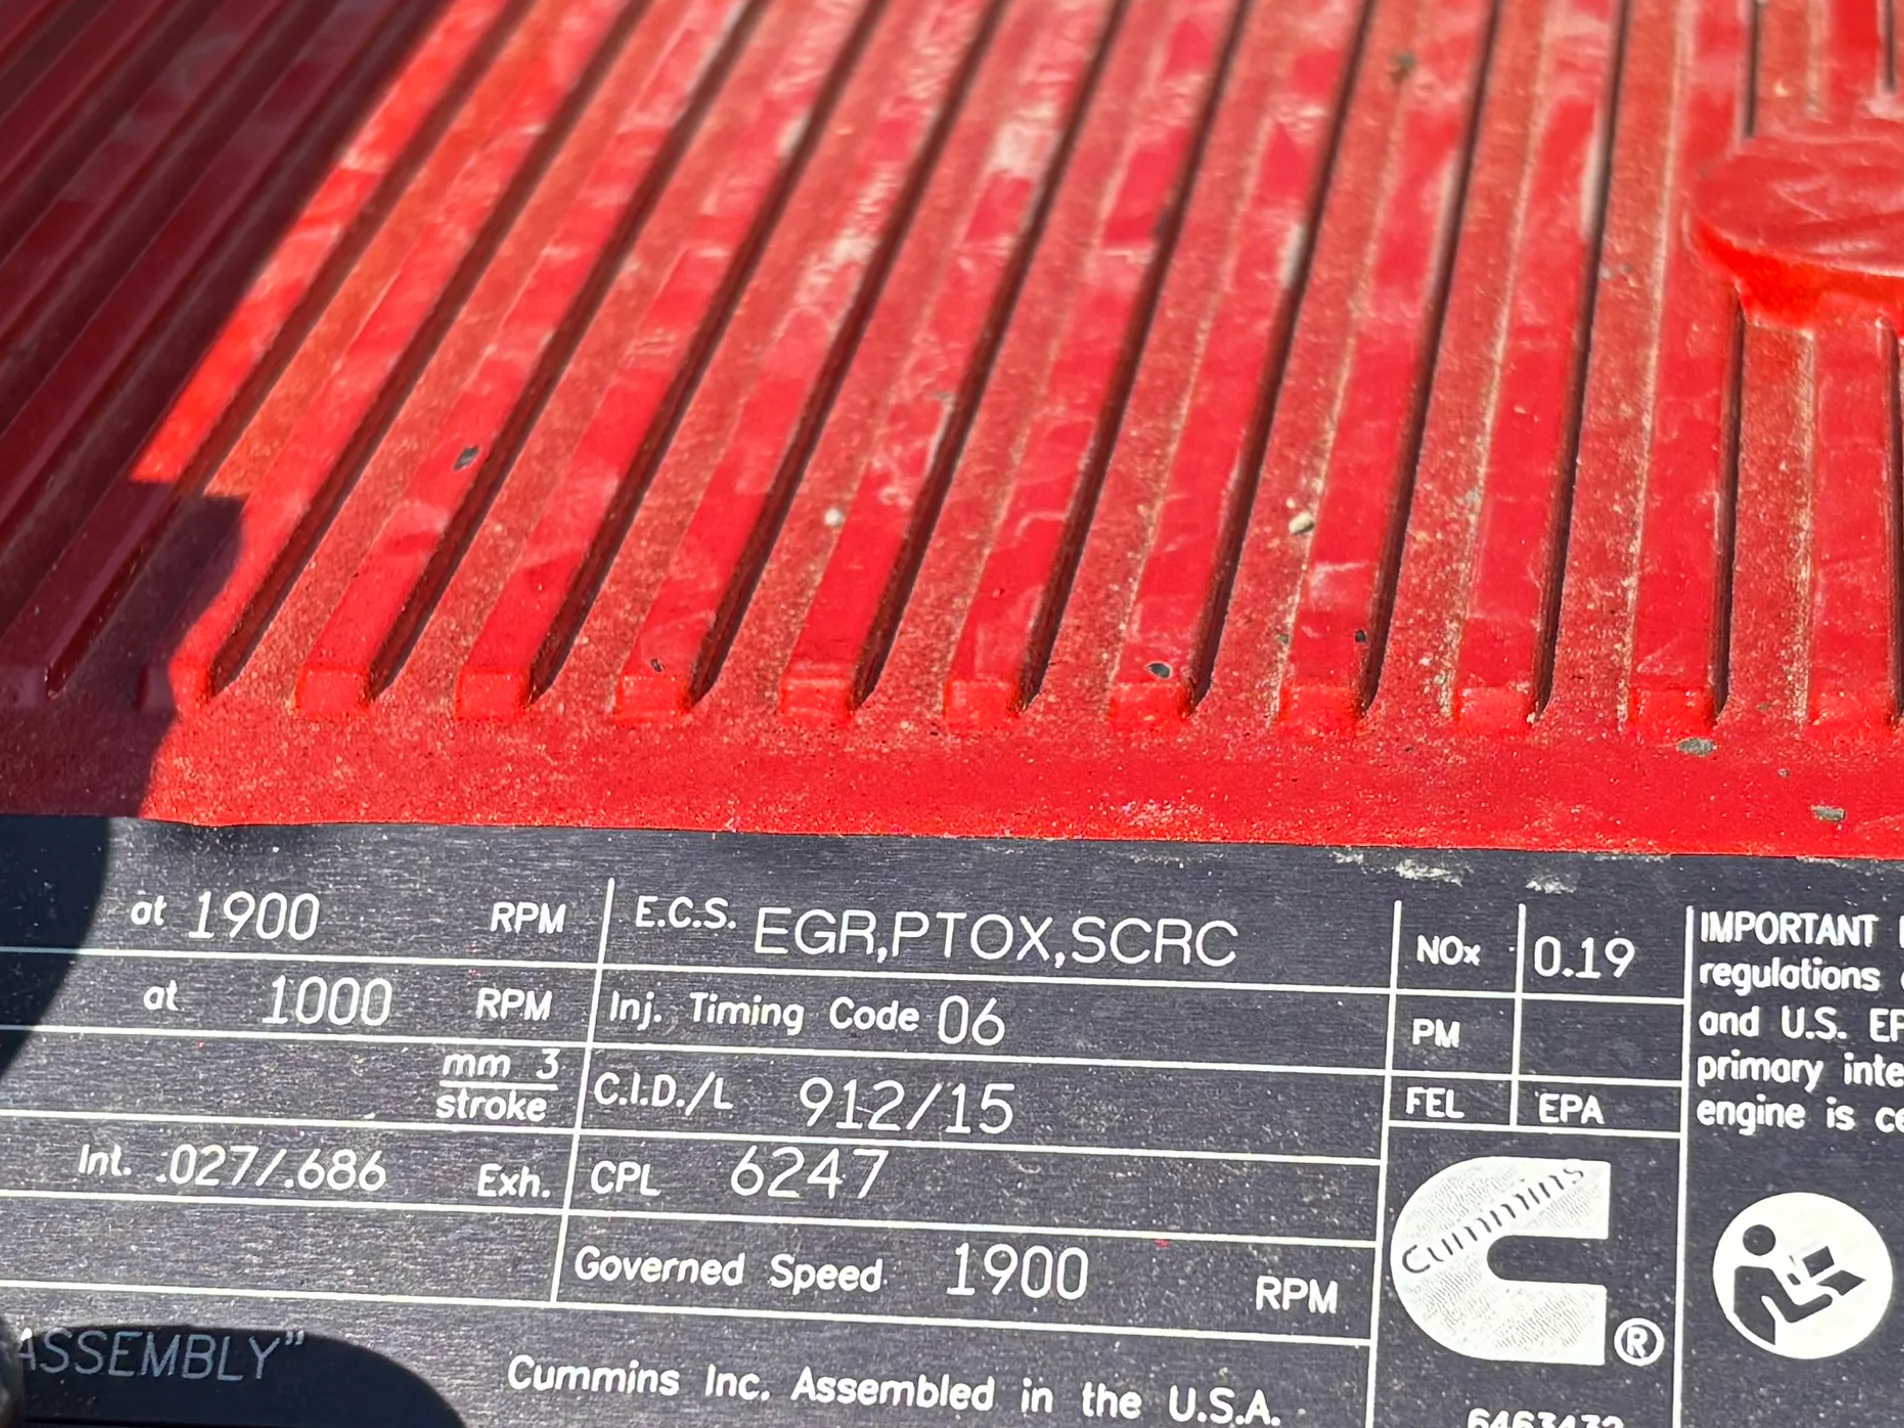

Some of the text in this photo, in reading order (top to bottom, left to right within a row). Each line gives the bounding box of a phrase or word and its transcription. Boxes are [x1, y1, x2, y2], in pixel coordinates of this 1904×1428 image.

[131, 890, 321, 942] at 1900
[490, 901, 566, 934] RPM
[634, 895, 1240, 969] E.C.S. EGR,PTOX,SCRC
[1699, 910, 1879, 949] IMPORTANT
[1415, 933, 1482, 967] NOx
[1533, 934, 1636, 980] 0.19
[1699, 956, 1881, 997] regulations
[143, 974, 395, 1027] at 1000
[475, 986, 553, 1022] RPM
[608, 992, 1008, 1048] Inj. Timing Code 06
[1411, 1017, 1461, 1049] PM
[1698, 1005, 1761, 1038] and
[1780, 1006, 1848, 1041] U.S.
[441, 1046, 561, 1080] mm 3
[1696, 1050, 1824, 1093] primary
[435, 1090, 548, 1122] stroke
[592, 1071, 1016, 1135] C.I.D./L 912/15
[1404, 1086, 1466, 1120] FEL
[1536, 1094, 1606, 1126] EPA
[1696, 1092, 1806, 1136] engine
[1825, 1095, 1856, 1131] is
[78, 1142, 132, 1176] Int.
[589, 1144, 890, 1201] CPL 6247
[475, 1163, 552, 1200] Exh.
[1400, 1162, 1586, 1276] Cummins
[573, 1245, 883, 1303] Governed Speed
[945, 1242, 1089, 1301] 1900
[1254, 1277, 1339, 1316] RPM
[507, 1353, 1283, 1428] Cummins Inc. Assembled in the U.S.A.
